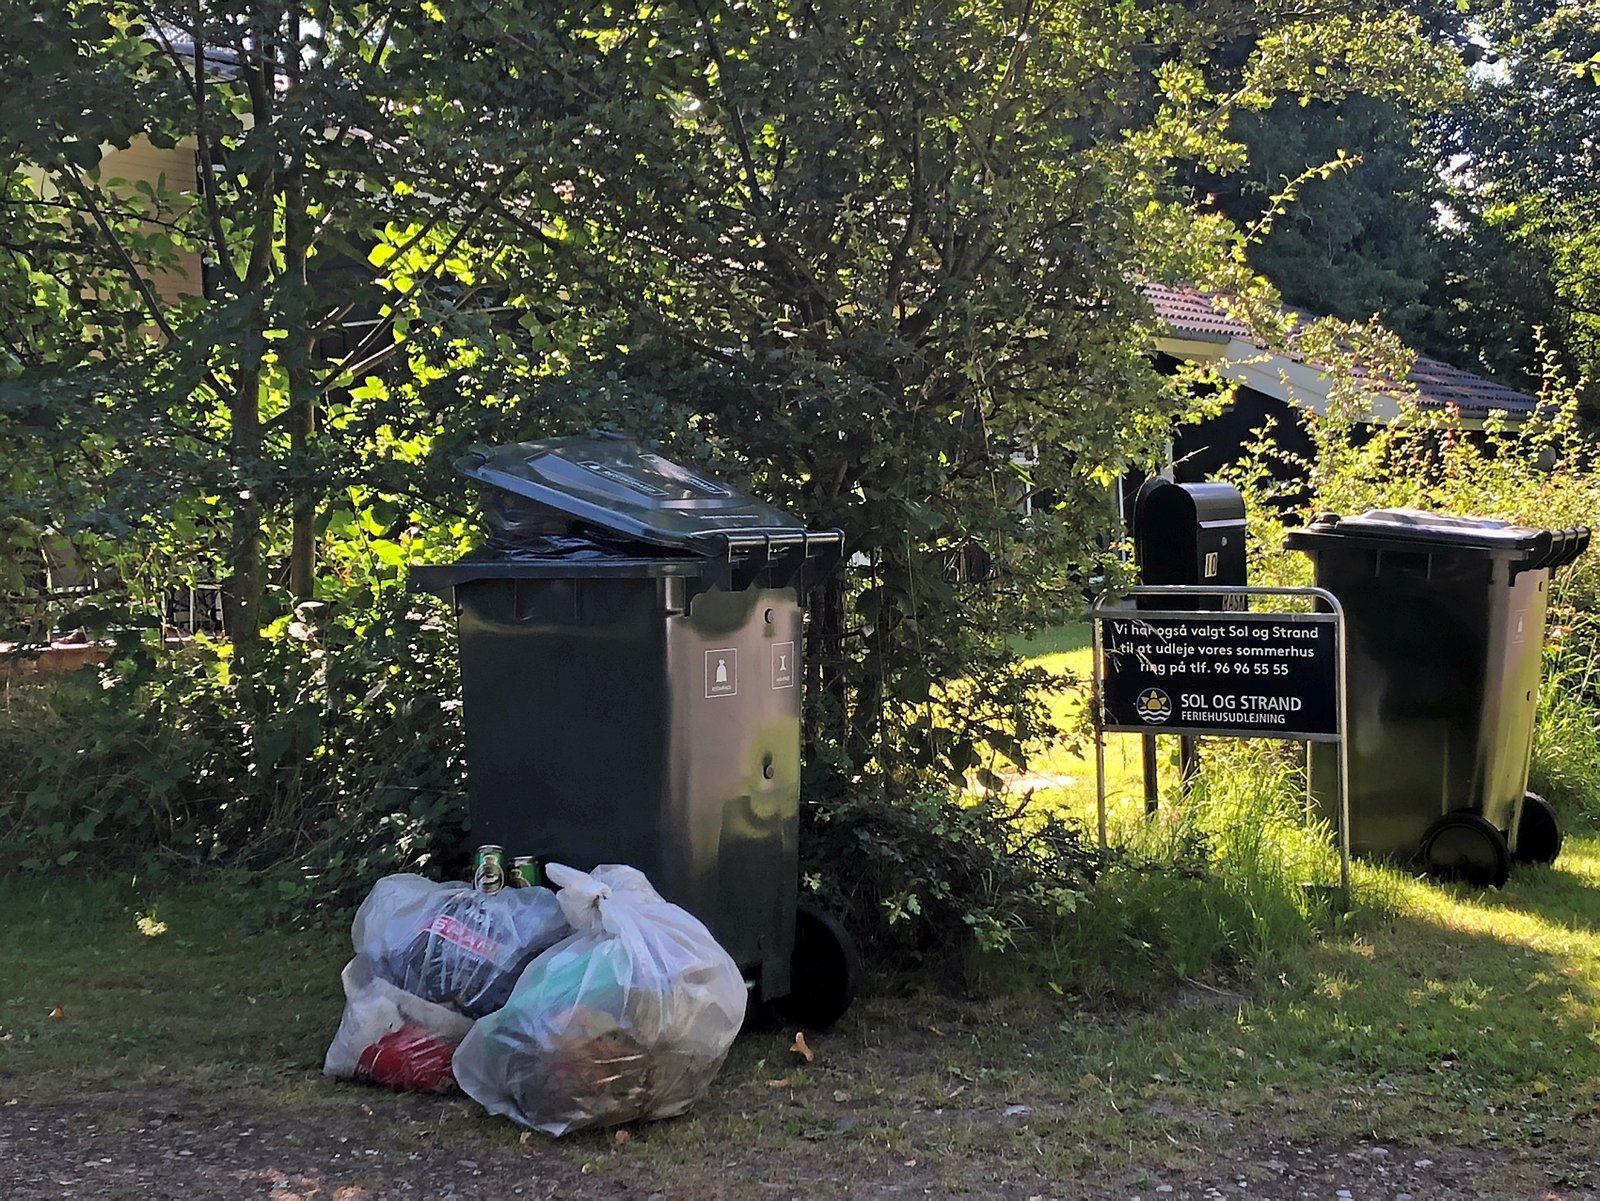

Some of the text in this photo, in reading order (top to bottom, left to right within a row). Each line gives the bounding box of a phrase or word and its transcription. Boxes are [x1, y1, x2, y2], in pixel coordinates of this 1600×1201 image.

[1206, 554, 1217, 575] 10
[1115, 623, 1319, 640] Vi har også valgt Sol og Strand
[1120, 643, 1315, 657] til at udleje vores sommerhus
[1140, 662, 1289, 675] ring på tlf. 96 96 55 55
[1181, 694, 1302, 711] SOL OG STRAND
[1181, 710, 1286, 724] FERIEHUSUDLEJNING
